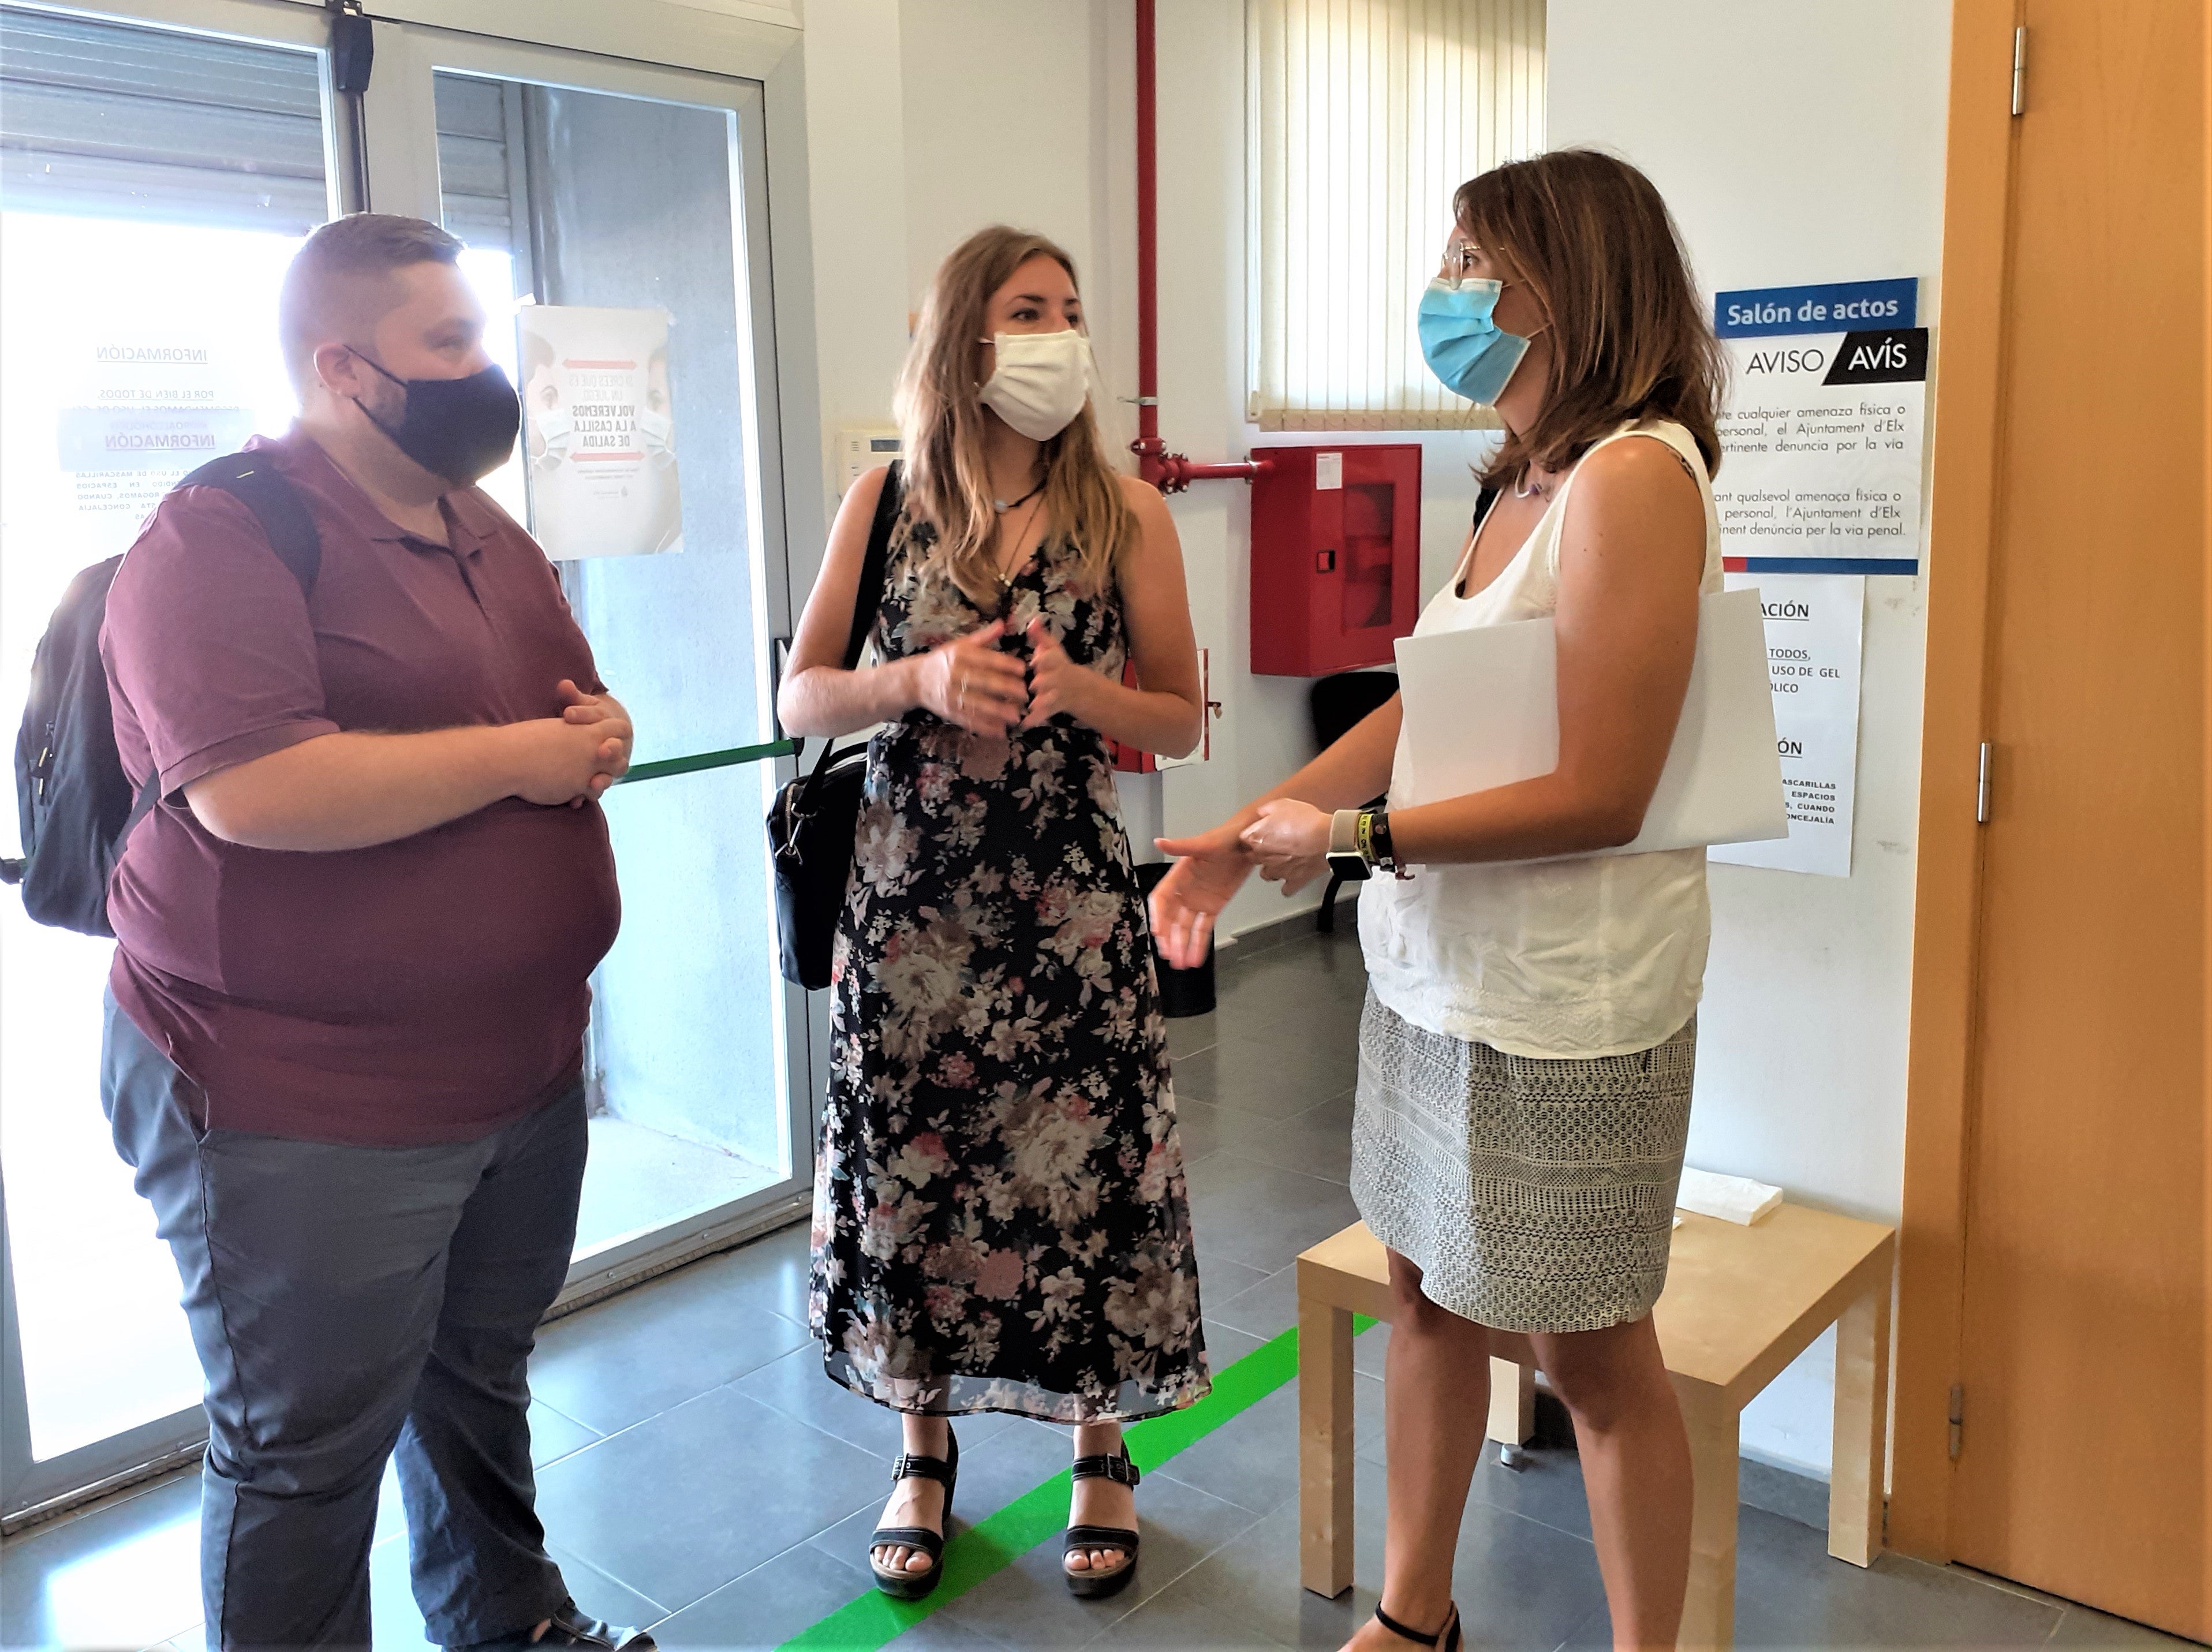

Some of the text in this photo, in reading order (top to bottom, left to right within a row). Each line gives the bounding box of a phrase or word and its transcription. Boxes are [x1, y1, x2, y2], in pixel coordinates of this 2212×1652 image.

[1727, 298, 1899, 326] Salón de actos
[1746, 349, 1824, 375] AVISO
[1848, 337, 1907, 371] AVÍS
[1738, 406, 1791, 421] cualquier
[1797, 408, 1852, 417] amenaza
[1897, 406, 1905, 414] o
[1777, 423, 1787, 435] el
[1796, 422, 1864, 438] Ajuntament
[1775, 439, 1829, 452] denuncia
[1836, 442, 1857, 454] por
[1865, 436, 1877, 450] la
[1714, 492, 1732, 502] ant
[1737, 488, 1790, 504] qualsevol
[1795, 493, 1850, 503] amenaça
[1893, 493, 1901, 501] o
[1725, 505, 1777, 521] personal,
[1806, 526, 1826, 539] per
[1829, 522, 1841, 535] la
[1867, 522, 1906, 539] penal.
[1769, 648, 1811, 660] TODOS,
[1772, 666, 1840, 678] USO DE GEL
[1782, 779, 1836, 790] ASCARILLAS
[1791, 791, 1836, 801] ESPACIOS
[1797, 803, 1835, 813] CUANDO
